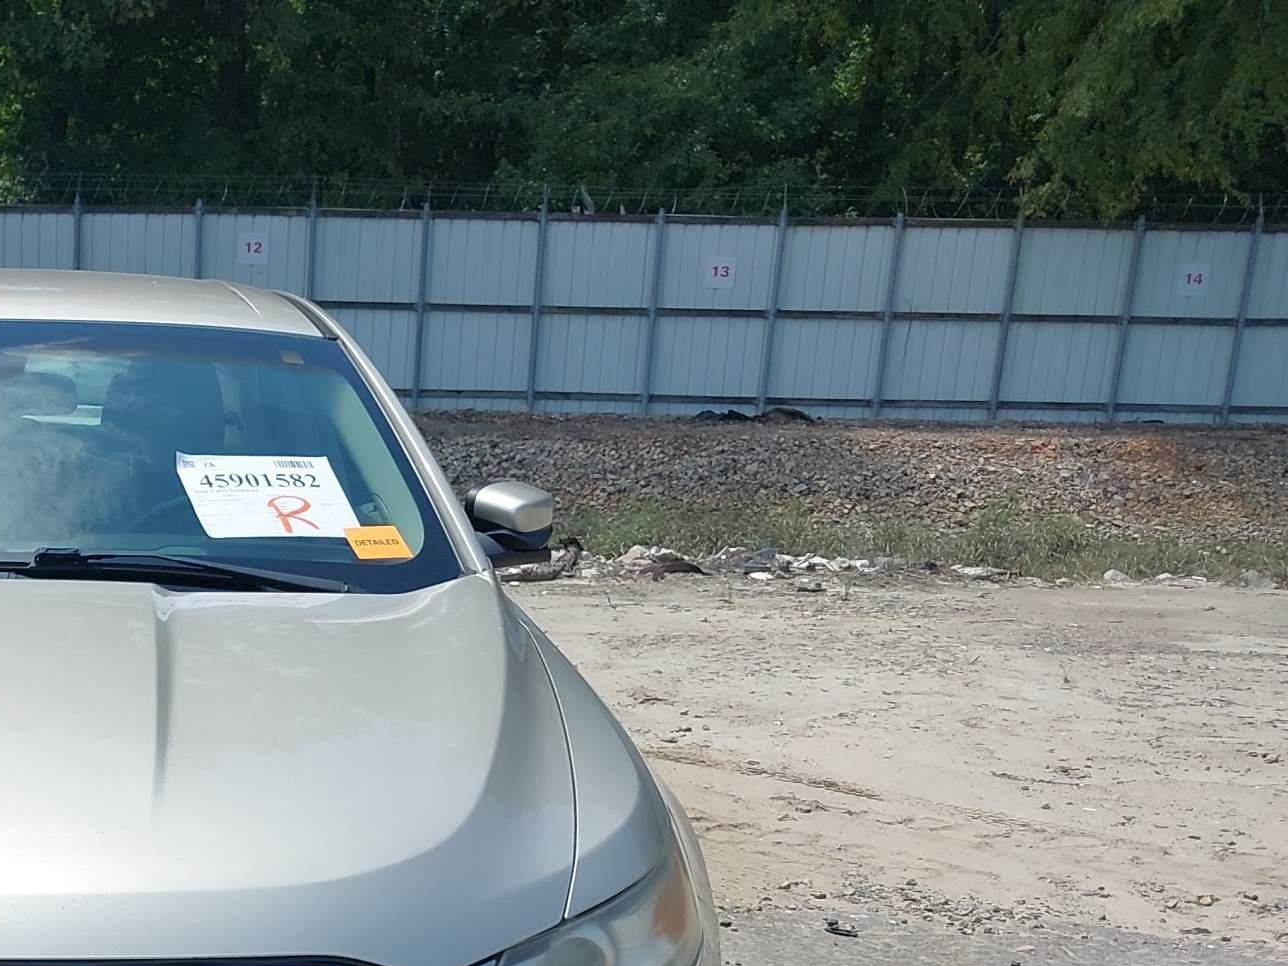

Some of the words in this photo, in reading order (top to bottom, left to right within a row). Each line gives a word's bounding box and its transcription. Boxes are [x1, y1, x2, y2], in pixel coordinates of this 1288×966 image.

[245, 241, 262, 254] 12
[712, 265, 730, 278] 13
[1185, 273, 1203, 285] 14
[199, 472, 321, 489] 45901582
[267, 495, 321, 534] R
[354, 538, 400, 547] DETAILED
